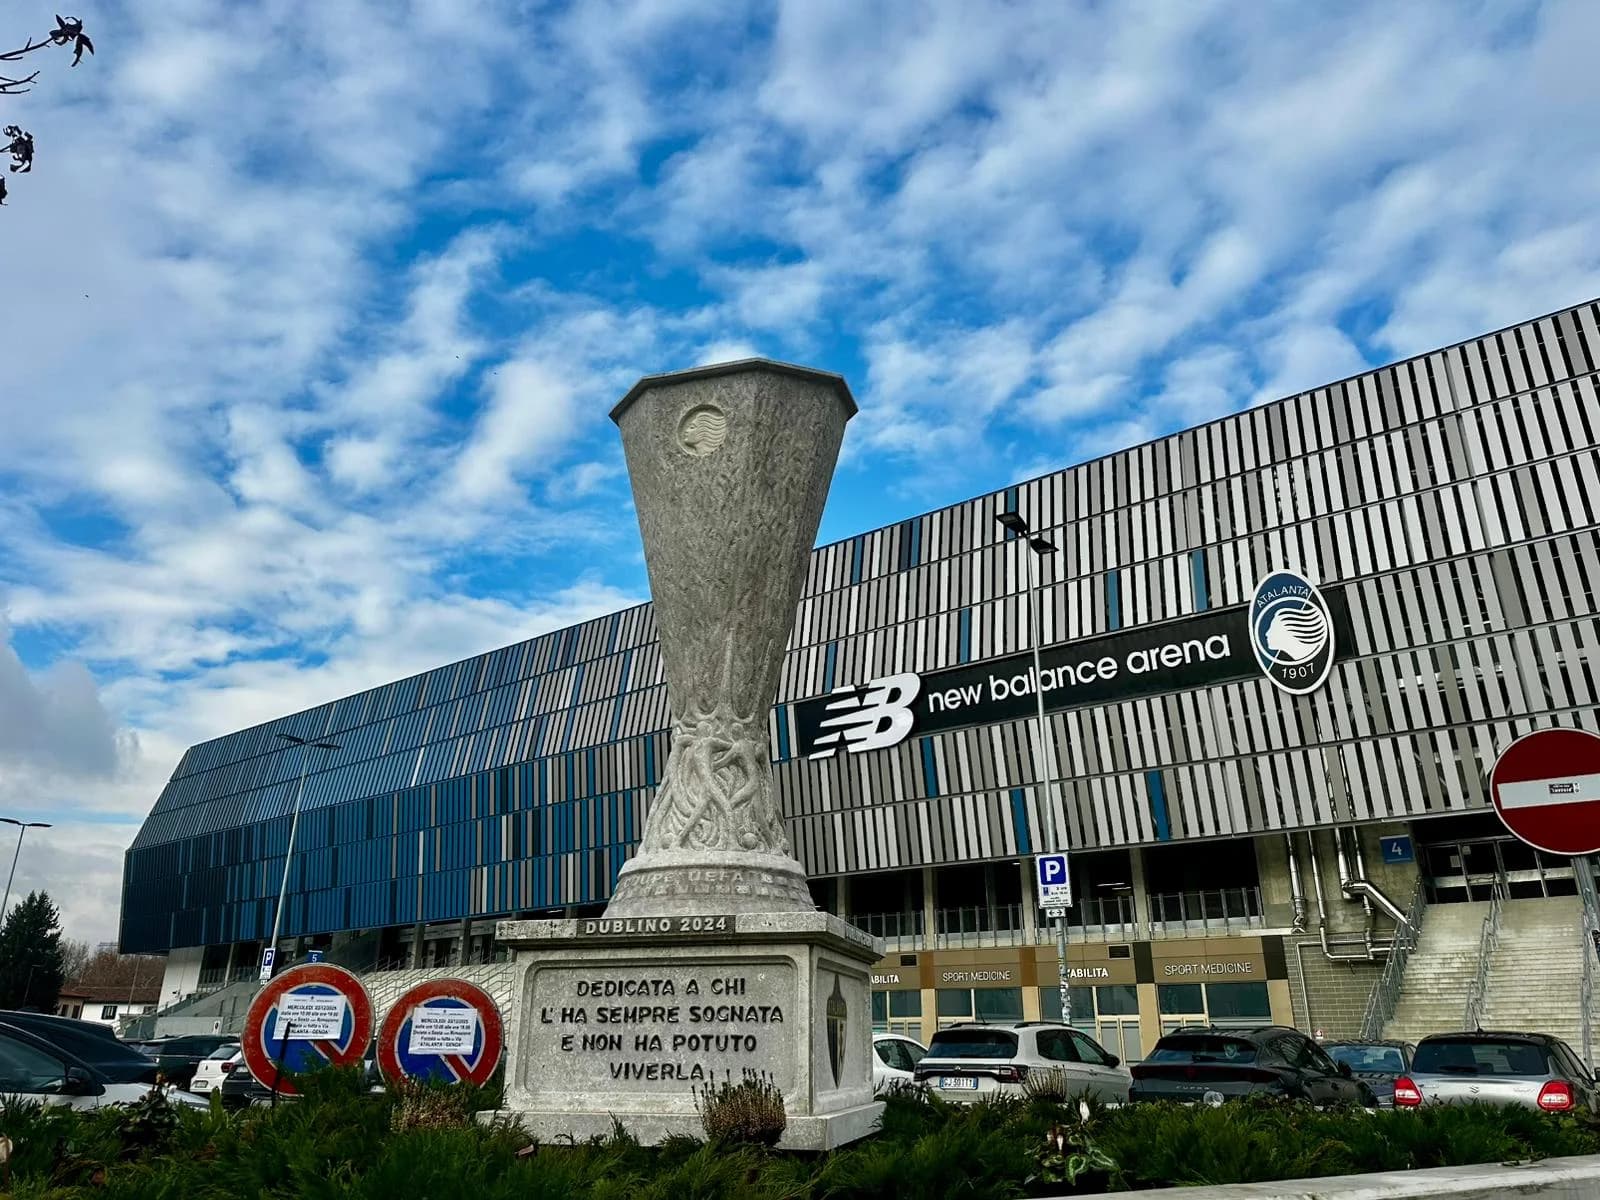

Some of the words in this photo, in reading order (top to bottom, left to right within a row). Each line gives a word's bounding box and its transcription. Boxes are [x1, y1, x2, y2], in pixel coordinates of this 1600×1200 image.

[1256, 585, 1309, 608] ATALANTA
[928, 682, 981, 713] new
[990, 659, 1118, 699] balance
[1127, 632, 1230, 674] arena
[1282, 663, 1315, 679] 1907
[1391, 842, 1402, 856] 4
[1044, 860, 1060, 882] P
[585, 918, 673, 935] DUBLINO
[680, 917, 727, 933] 2024
[942, 972, 969, 982] SPORT
[970, 971, 1010, 981] MEDICINE
[1067, 967, 1109, 978] ABILITA
[1164, 964, 1198, 976] SPORT
[1201, 963, 1252, 975] MEDICINE
[577, 979, 676, 996] DEDICATA
[686, 979, 700, 995] A
[711, 977, 745, 995] CHI
[596, 1006, 680, 1024] SEMPRE
[690, 1005, 784, 1024] SOGNATA
[561, 1035, 574, 1051] E
[582, 1034, 623, 1052] NON
[634, 1034, 663, 1052] HA
[672, 1033, 757, 1052] POTUTO
[610, 1063, 705, 1080] VIVERLA
